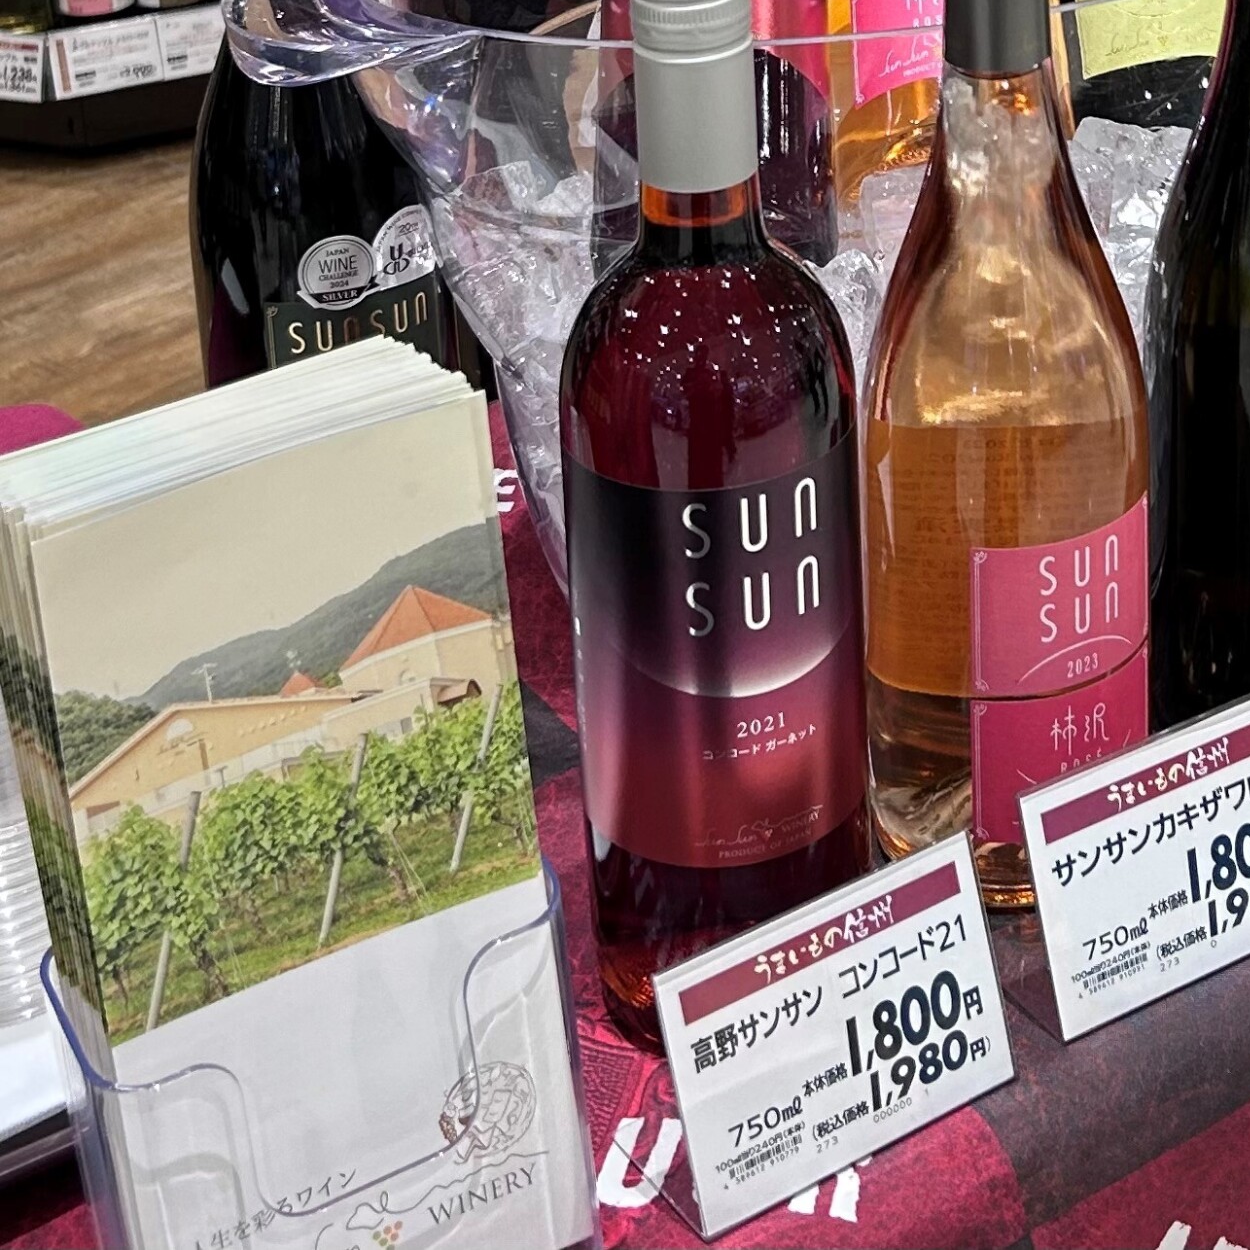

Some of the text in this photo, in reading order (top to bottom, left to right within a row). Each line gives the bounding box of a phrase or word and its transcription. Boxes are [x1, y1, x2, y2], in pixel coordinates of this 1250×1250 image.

[318, 254, 359, 275] WINE
[325, 247, 351, 258] JAPAN
[318, 269, 359, 282] CHALLENGE
[322, 289, 358, 302] SILVER
[1066, 656, 1100, 679] 2023
[736, 711, 786, 739] 2021
[702, 723, 817, 761] コンコード ガーネット
[1106, 736, 1231, 813] うまいもの信州
[1147, 888, 1189, 920] 本体価格
[753, 893, 894, 985] うまいもの信州
[1159, 956, 1180, 973] 273
[690, 913, 967, 1074] 高野サンサン コンコード21
[801, 1062, 849, 1099] 本体価格
[845, 969, 985, 1077] 1,800円
[815, 1134, 840, 1155] 273
[427, 1162, 538, 1226] WINERY
